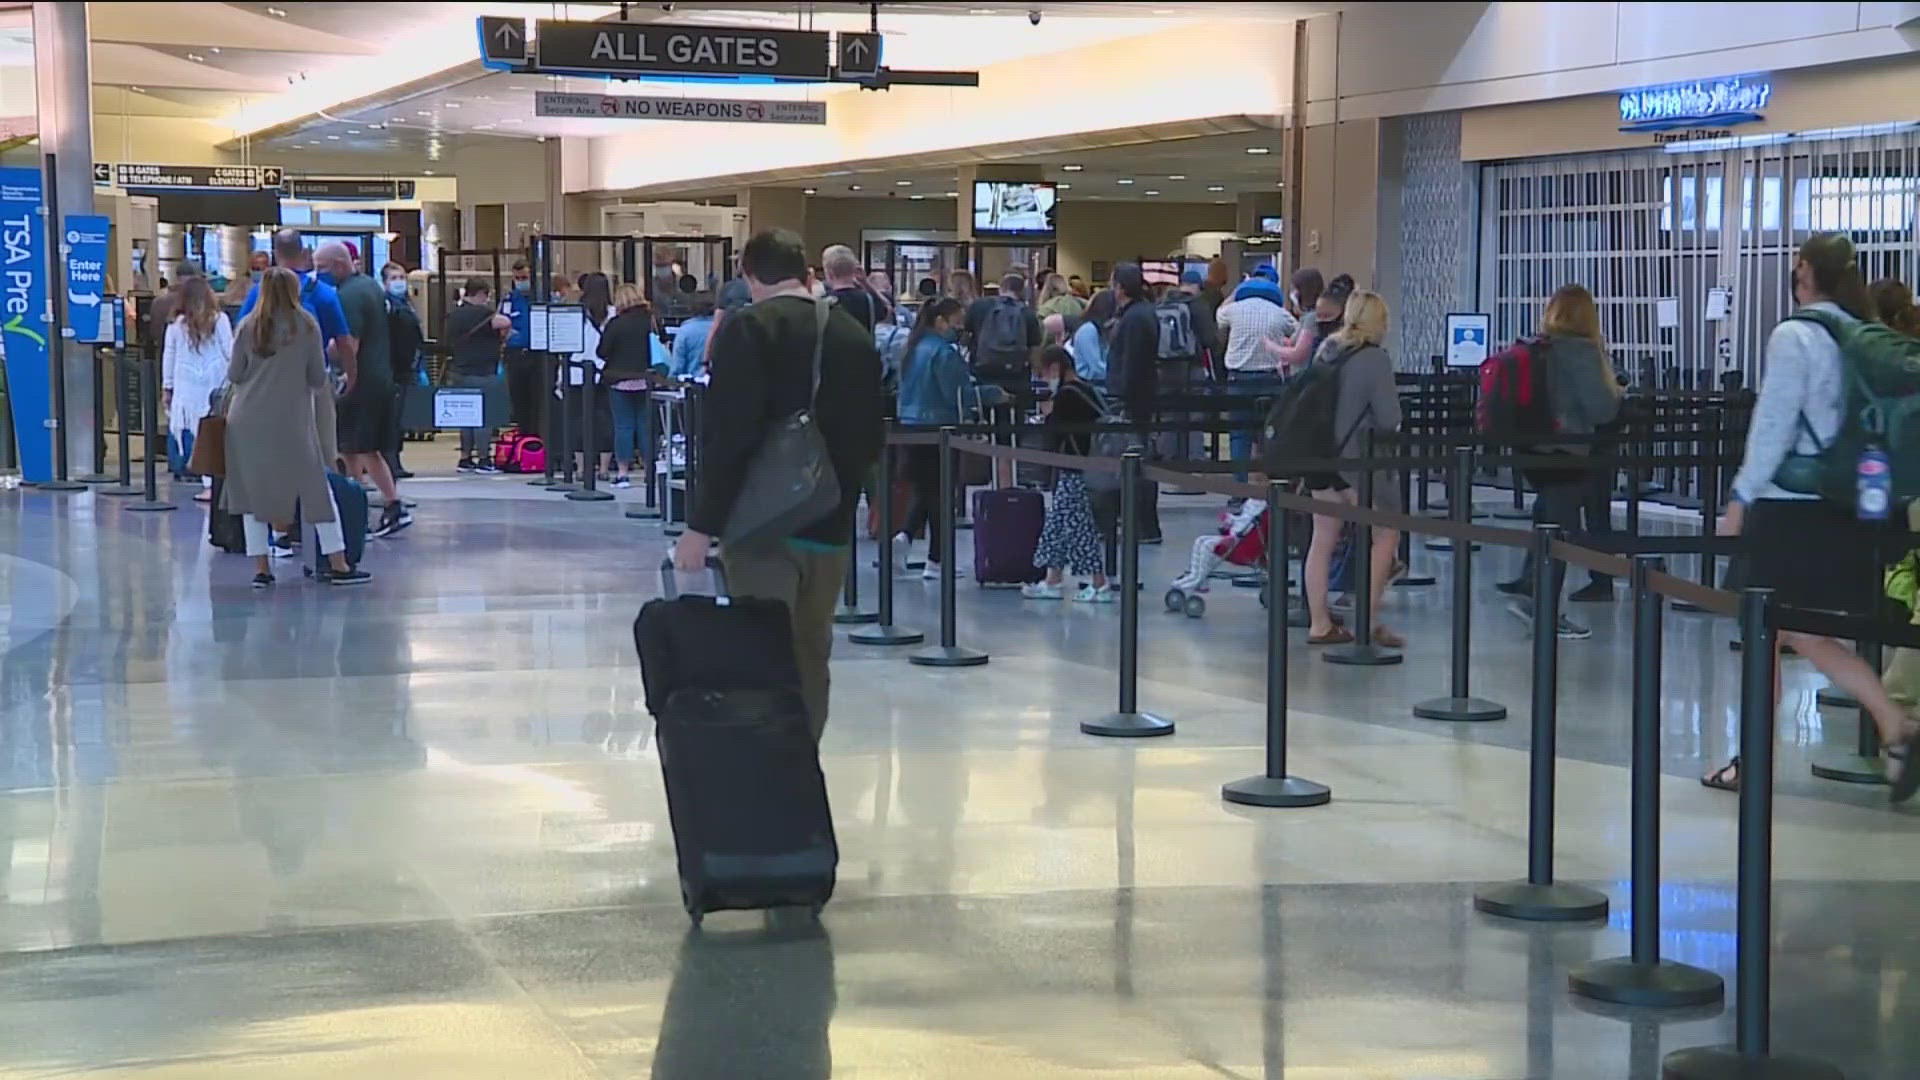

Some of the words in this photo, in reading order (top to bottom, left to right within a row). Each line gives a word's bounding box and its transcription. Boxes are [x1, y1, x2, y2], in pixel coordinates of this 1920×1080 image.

[590, 31, 657, 61] ALL
[667, 35, 779, 67] GATES
[625, 100, 650, 114] NO
[655, 101, 742, 117] WEAPONS
[135, 165, 160, 175] GATES
[222, 169, 246, 178] GATES
[3, 214, 32, 265] TSA
[69, 259, 102, 271] Enter
[71, 270, 101, 282] Here
[5, 271, 33, 314] Pre
